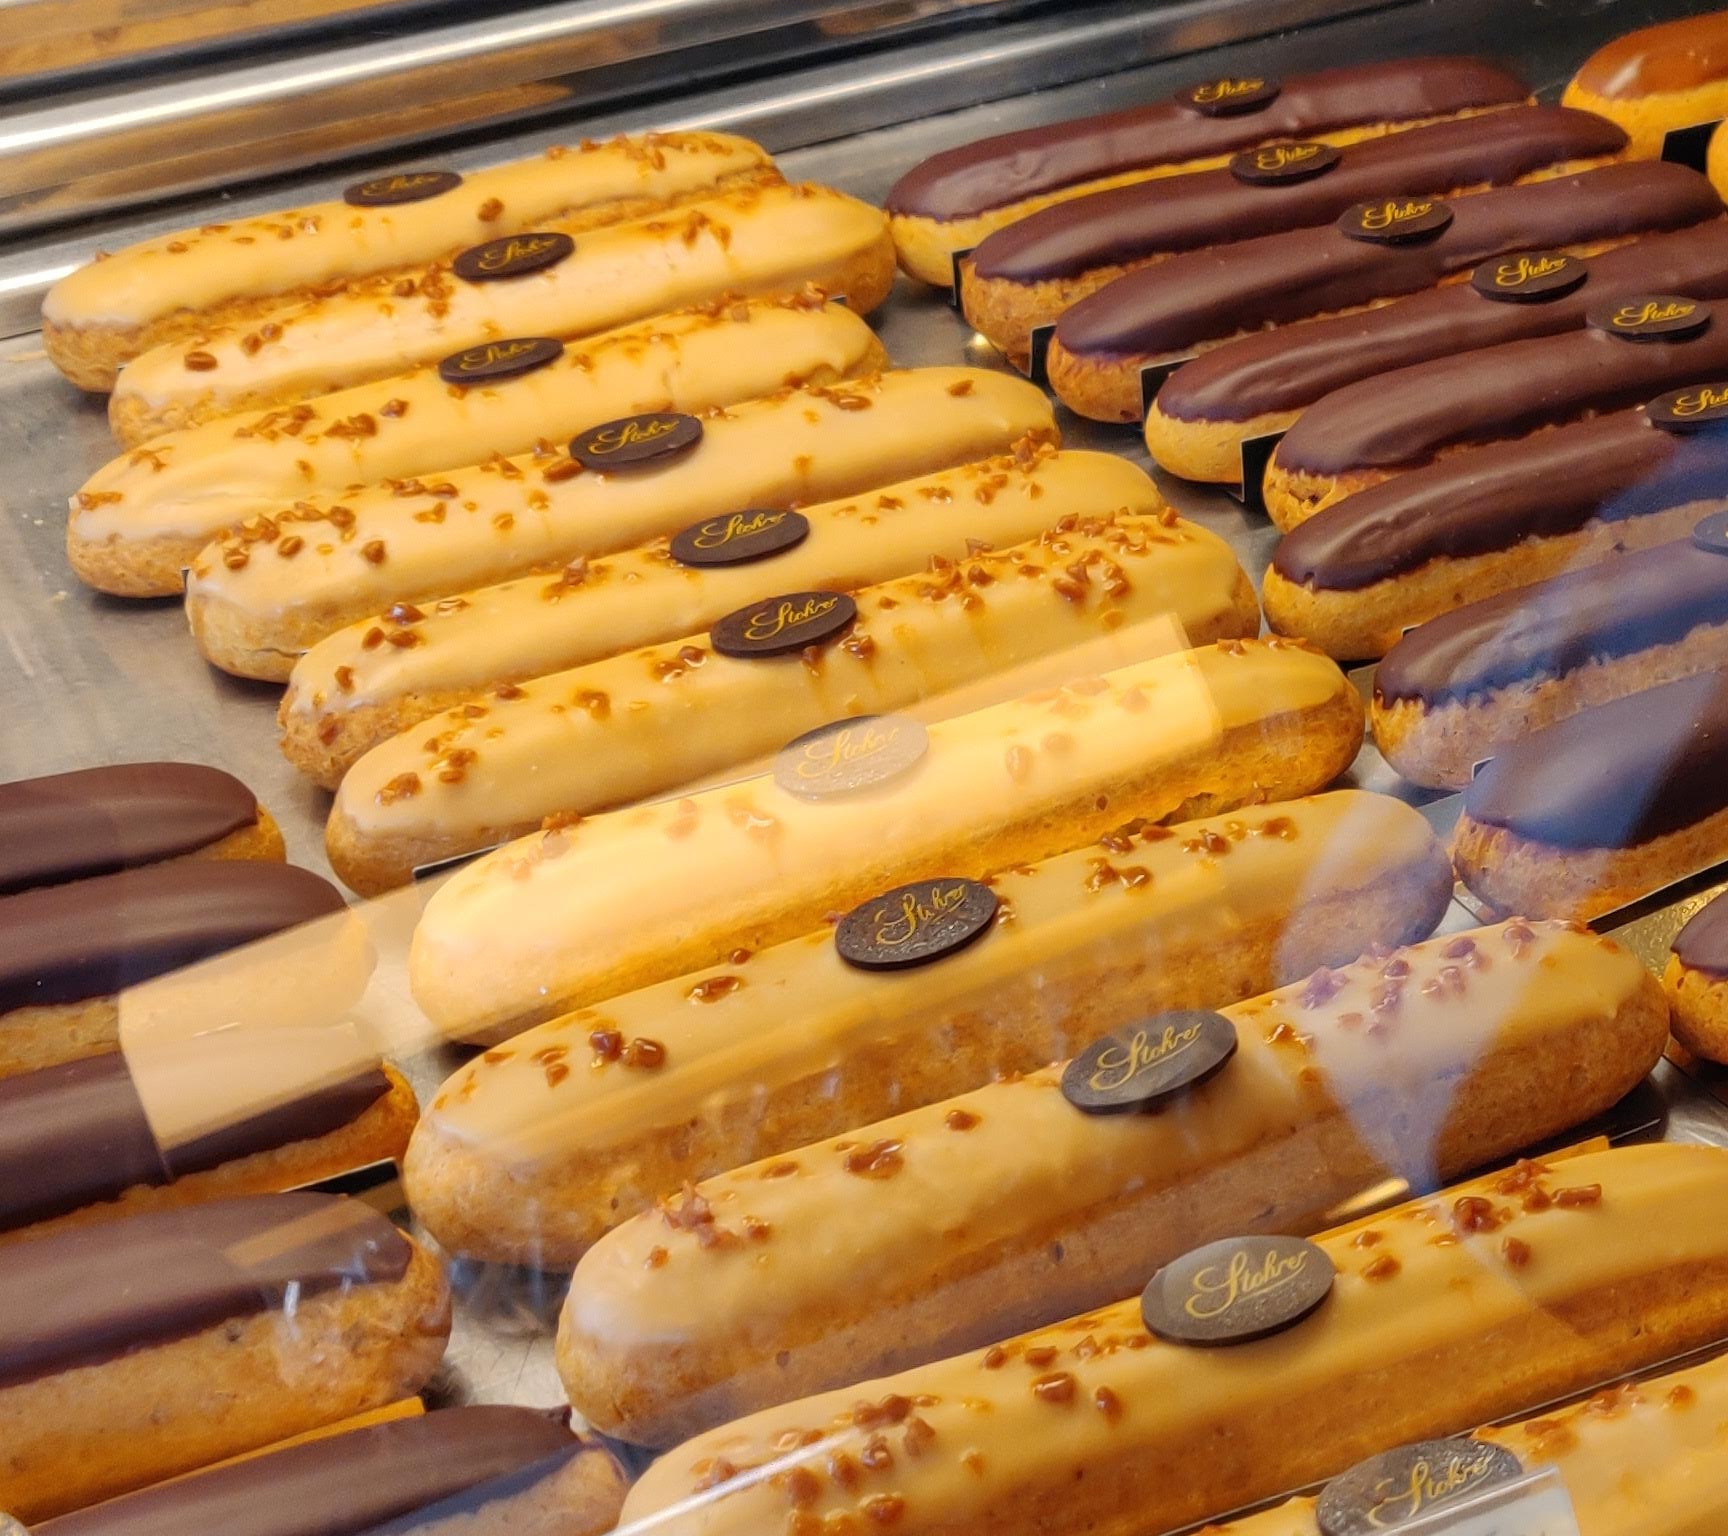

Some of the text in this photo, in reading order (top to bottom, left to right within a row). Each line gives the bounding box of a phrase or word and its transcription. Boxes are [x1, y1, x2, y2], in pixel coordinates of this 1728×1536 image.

[693, 511, 788, 548] Stohrer
[744, 596, 838, 641] Stohrer
[1089, 1021, 1203, 1091] Stohrer
[1185, 1250, 1308, 1319] Stohrer
